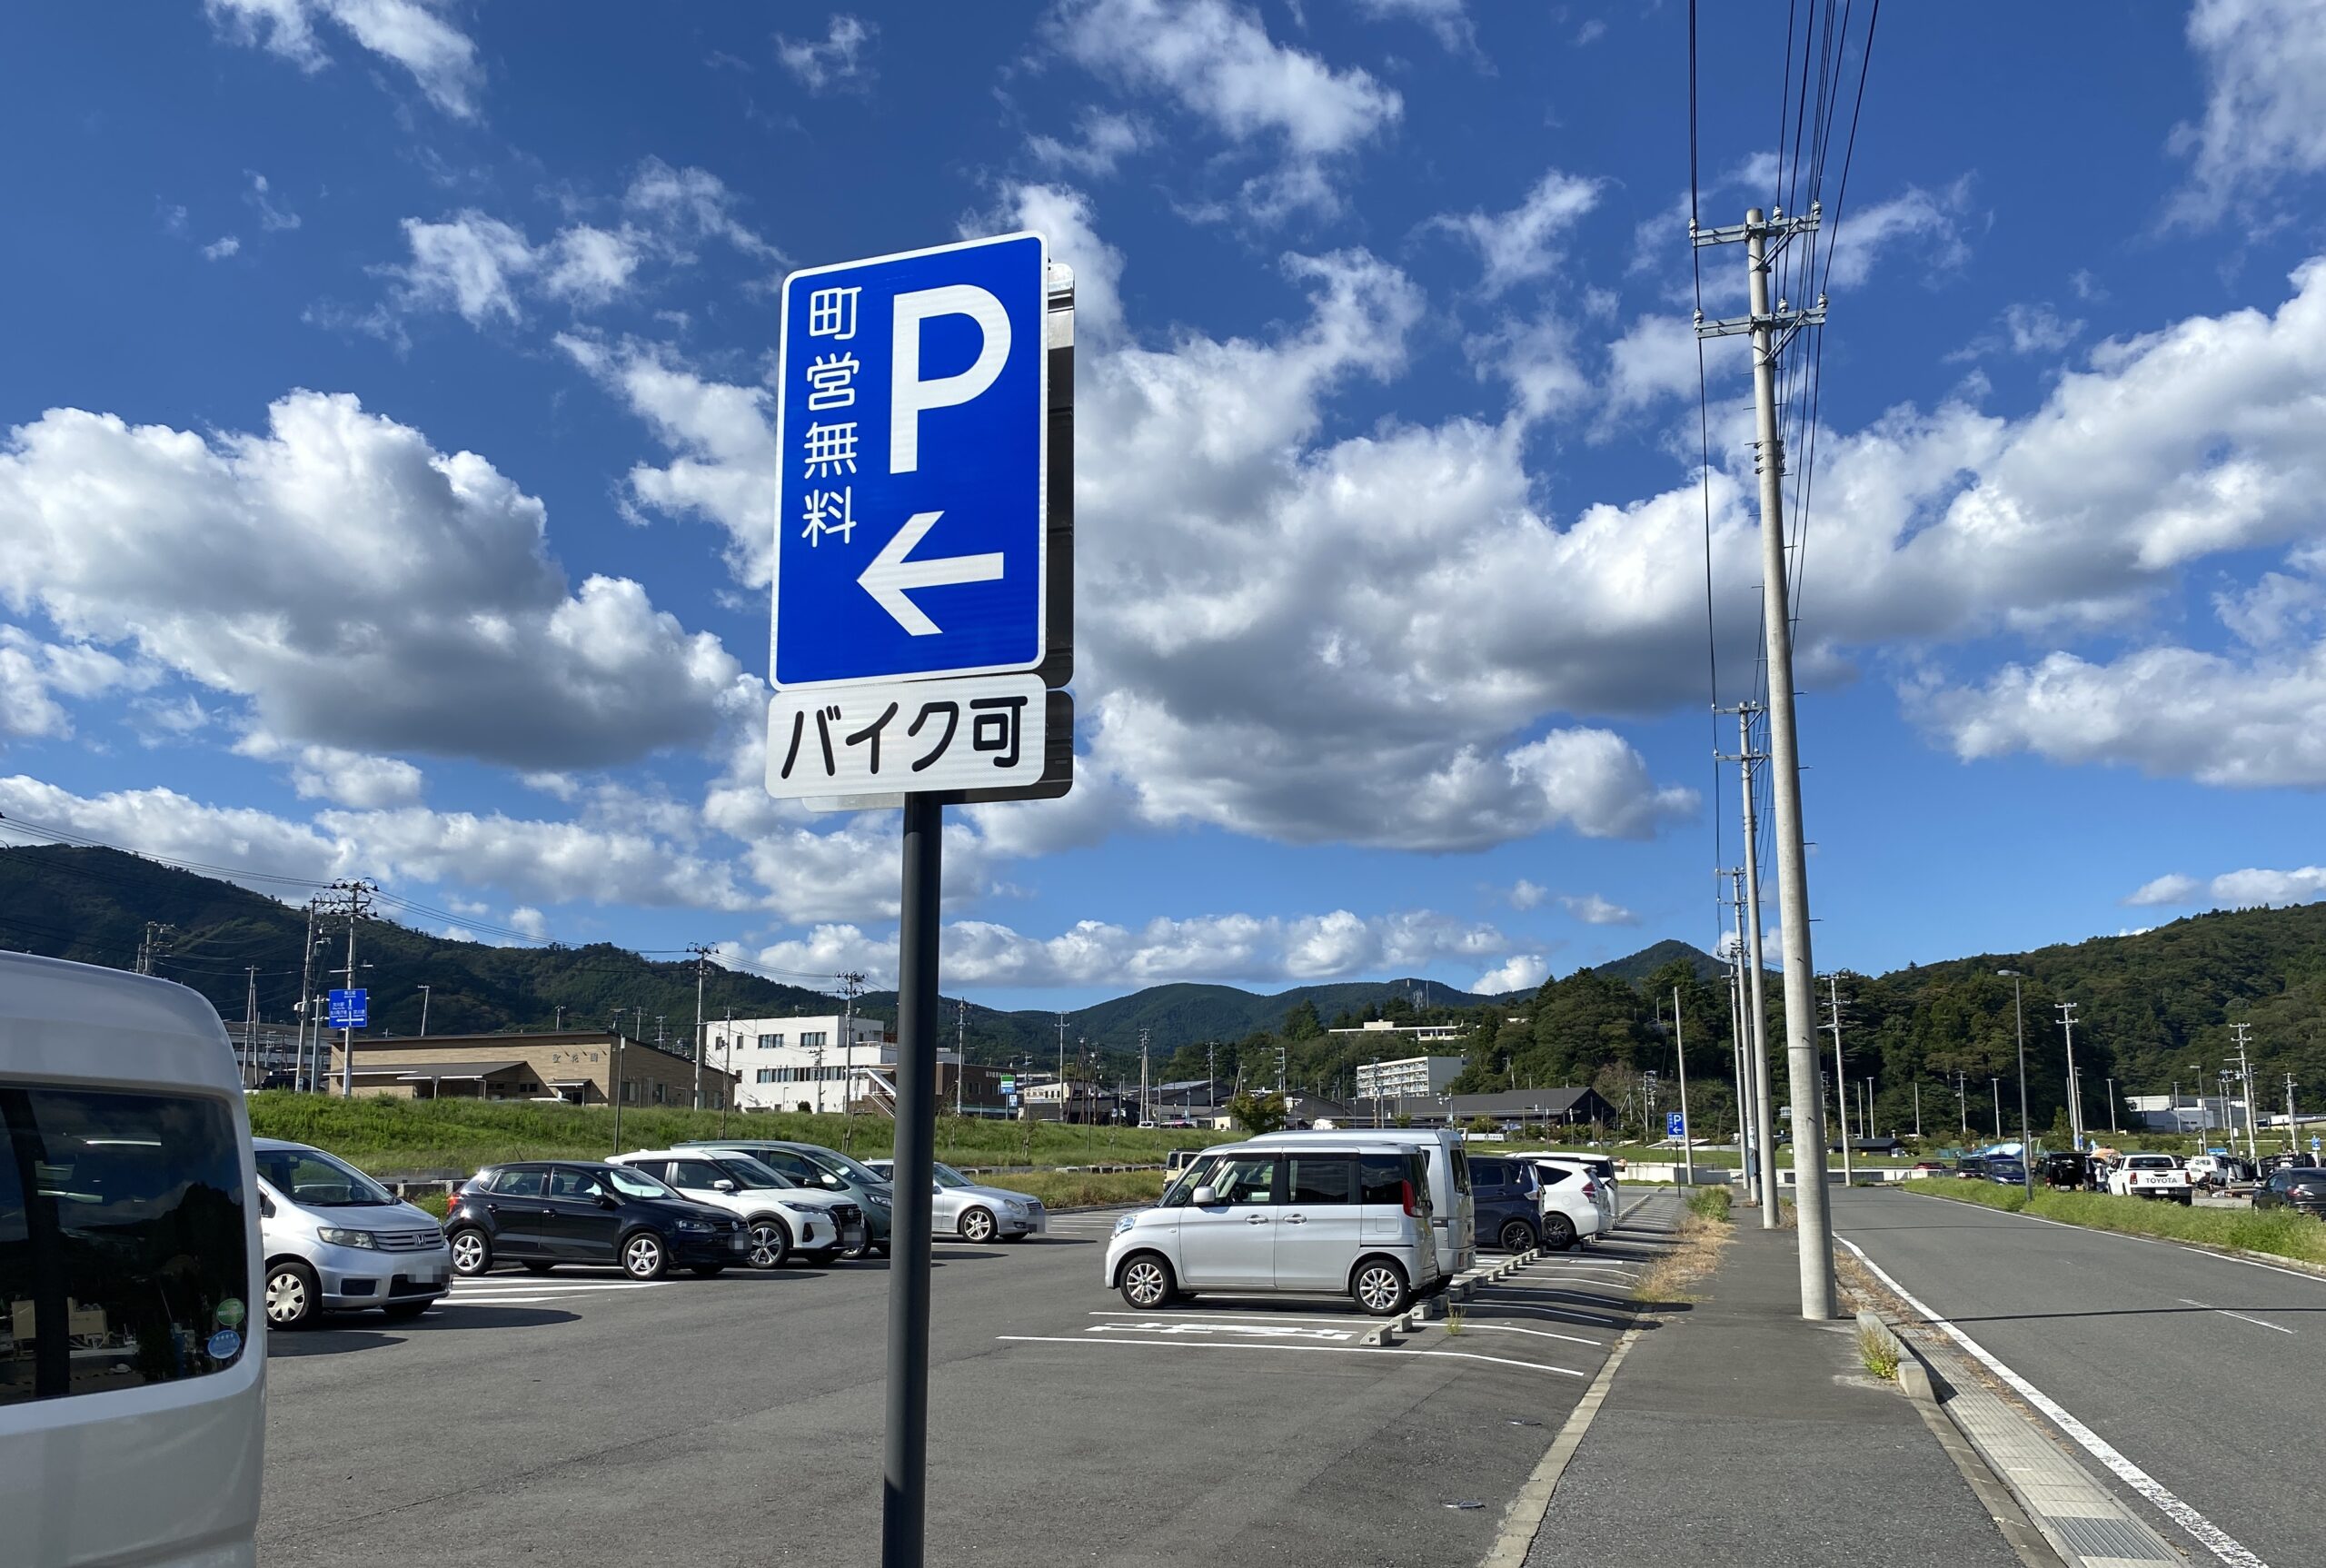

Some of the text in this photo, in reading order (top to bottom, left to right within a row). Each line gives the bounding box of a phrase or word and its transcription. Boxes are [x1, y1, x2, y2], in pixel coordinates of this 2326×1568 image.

[801, 285, 862, 548] 町営無料
[890, 283, 1012, 474] P
[780, 695, 1029, 779] バイク可
[1674, 1115, 1681, 1125] P
